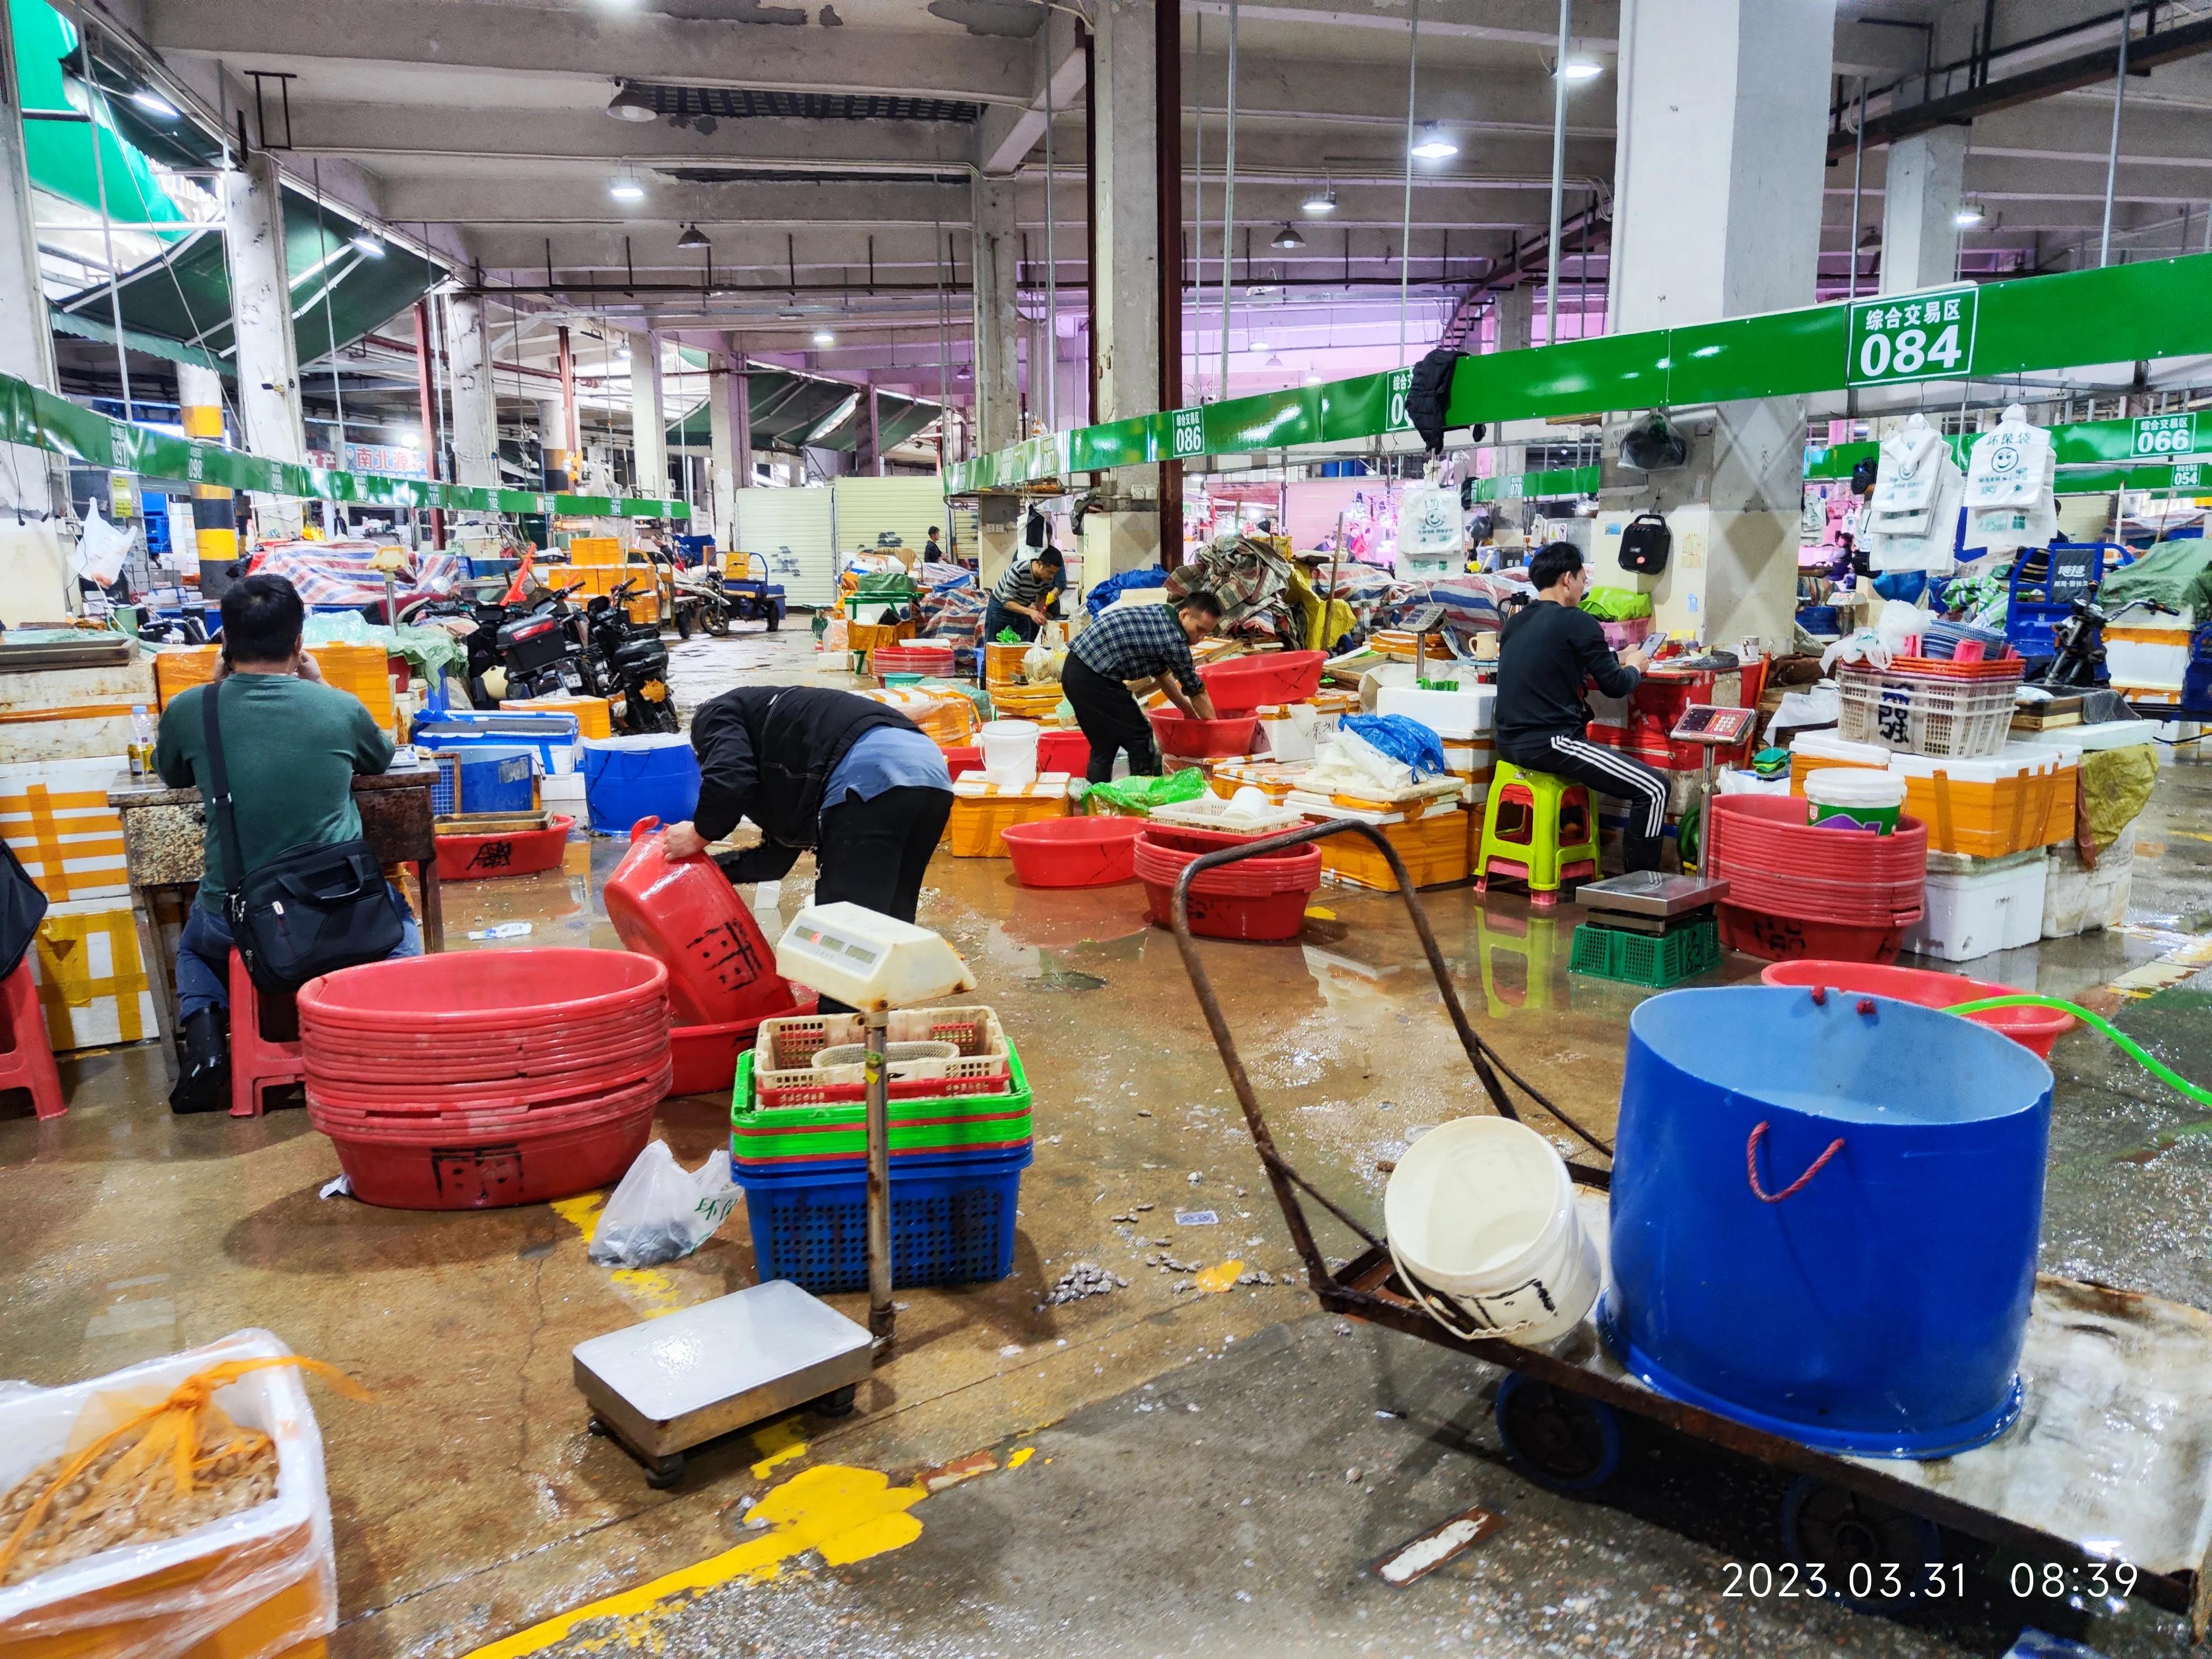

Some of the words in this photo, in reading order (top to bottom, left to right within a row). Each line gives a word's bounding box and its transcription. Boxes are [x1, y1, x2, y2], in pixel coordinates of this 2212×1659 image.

[1865, 299, 1960, 331] 综合交易区
[1861, 325, 1961, 376] 084
[2141, 417, 2188, 431] 综合交易区
[1176, 426, 1201, 453] 086
[1987, 433, 2031, 446] 环保袋
[2137, 429, 2189, 453] 066
[1044, 451, 1054, 471] 087
[189, 458, 203, 480] 098
[2174, 471, 2198, 485] 054
[1510, 483, 1522, 496] 070
[429, 491, 440, 505] 101
[488, 496, 499, 509] 102
[544, 501, 555, 512] 103
[611, 504, 621, 514] 104
